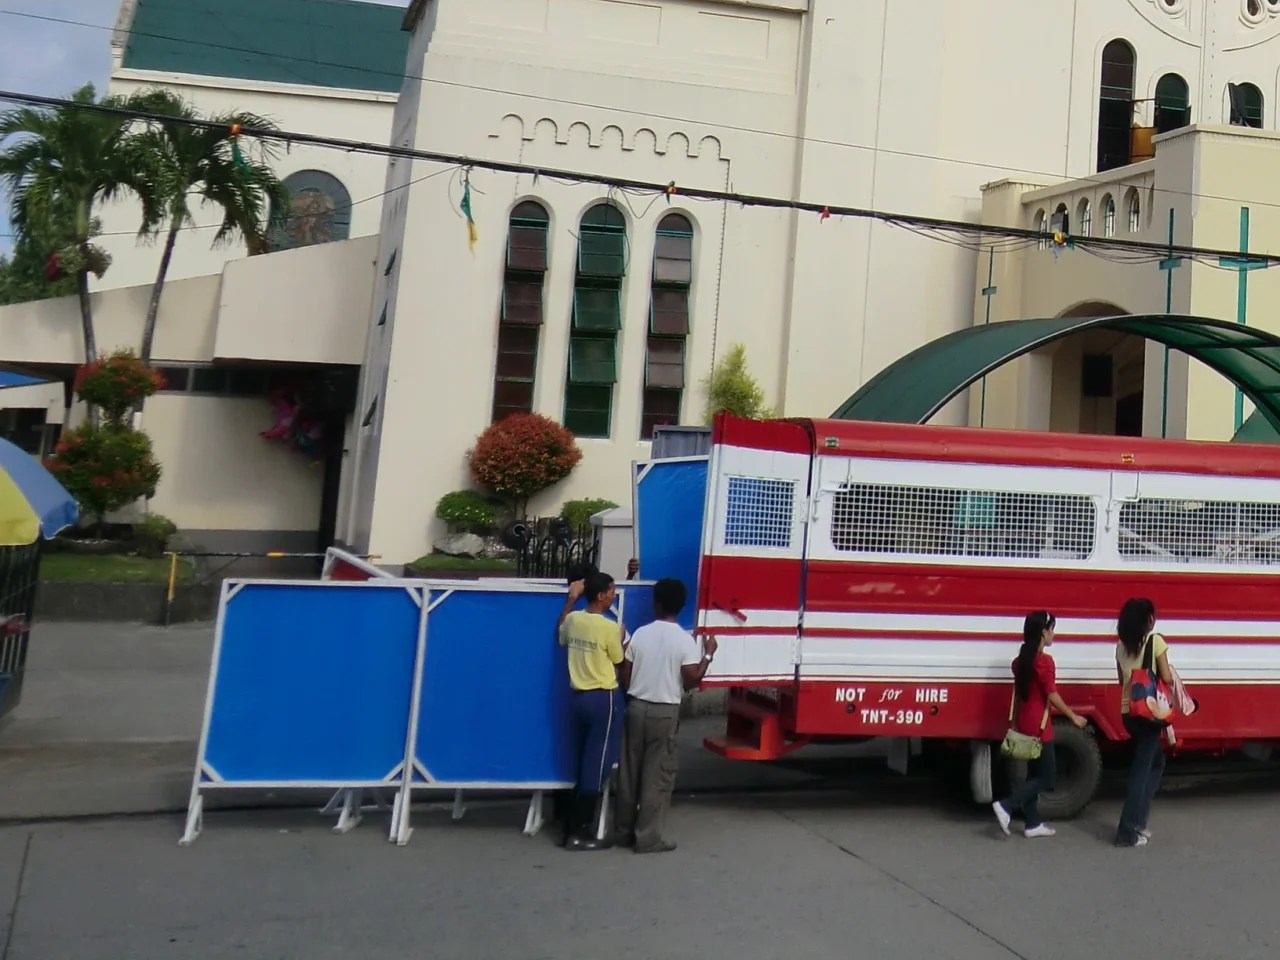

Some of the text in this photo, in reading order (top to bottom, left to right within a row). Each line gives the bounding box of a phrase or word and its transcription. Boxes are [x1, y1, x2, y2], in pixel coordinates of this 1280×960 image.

[835, 688, 948, 703] NOT for HIRE
[860, 709, 924, 725] TNT-390
